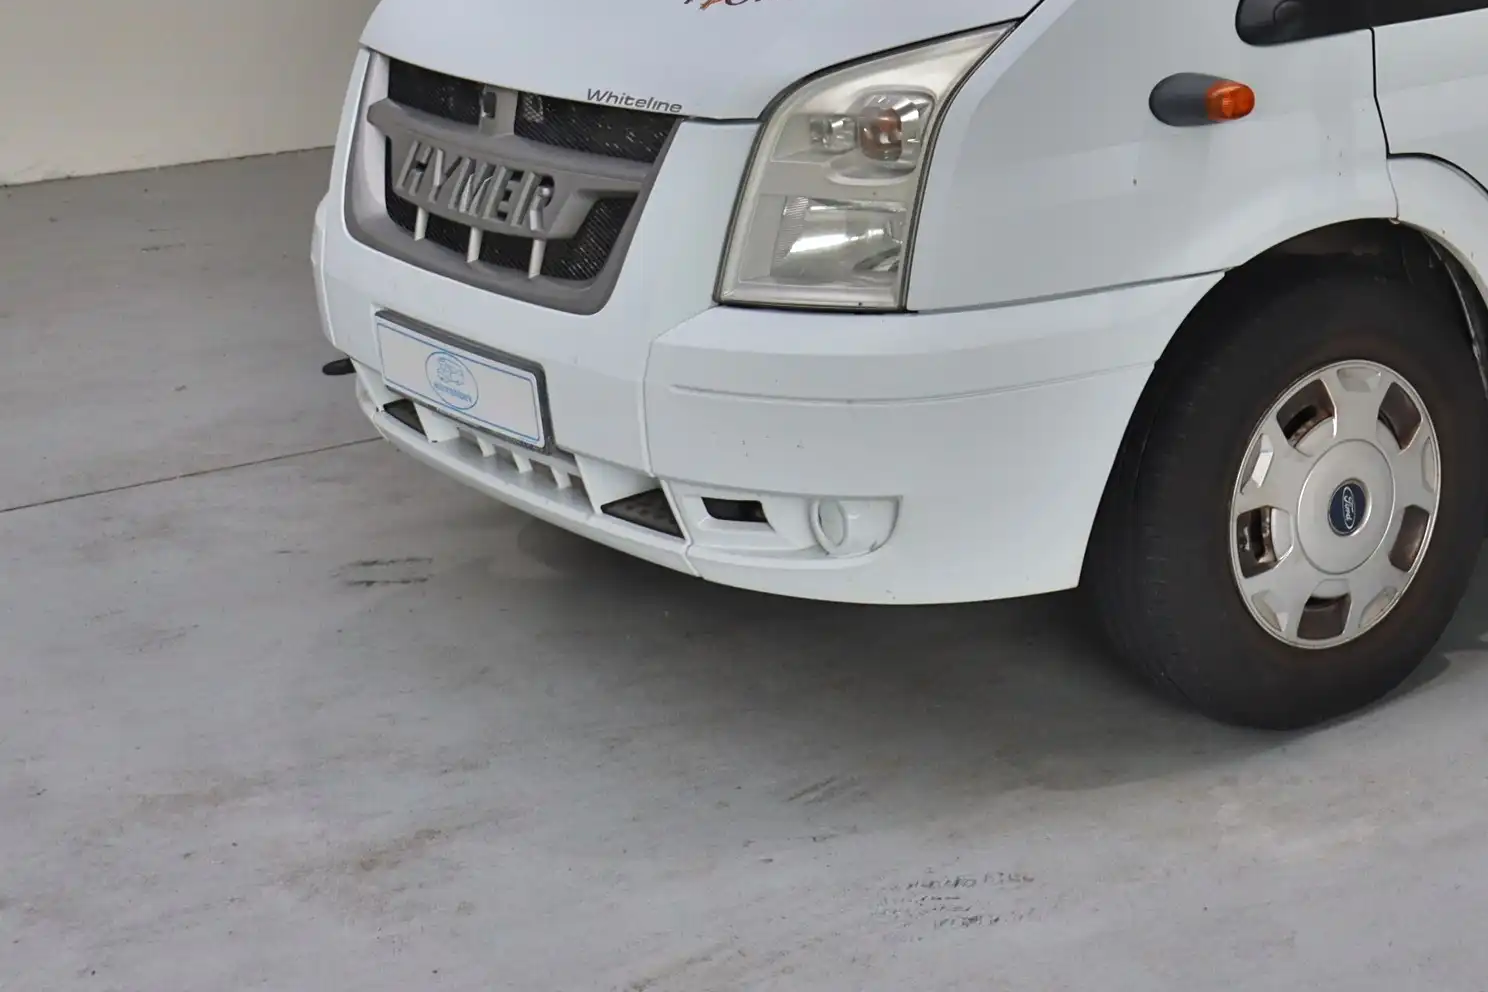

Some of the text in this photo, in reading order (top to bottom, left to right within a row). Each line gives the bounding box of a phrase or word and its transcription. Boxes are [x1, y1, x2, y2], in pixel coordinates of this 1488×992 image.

[586, 88, 683, 113] Whiteline
[395, 140, 555, 232] HYMER
[1343, 495, 1354, 521] Ford
